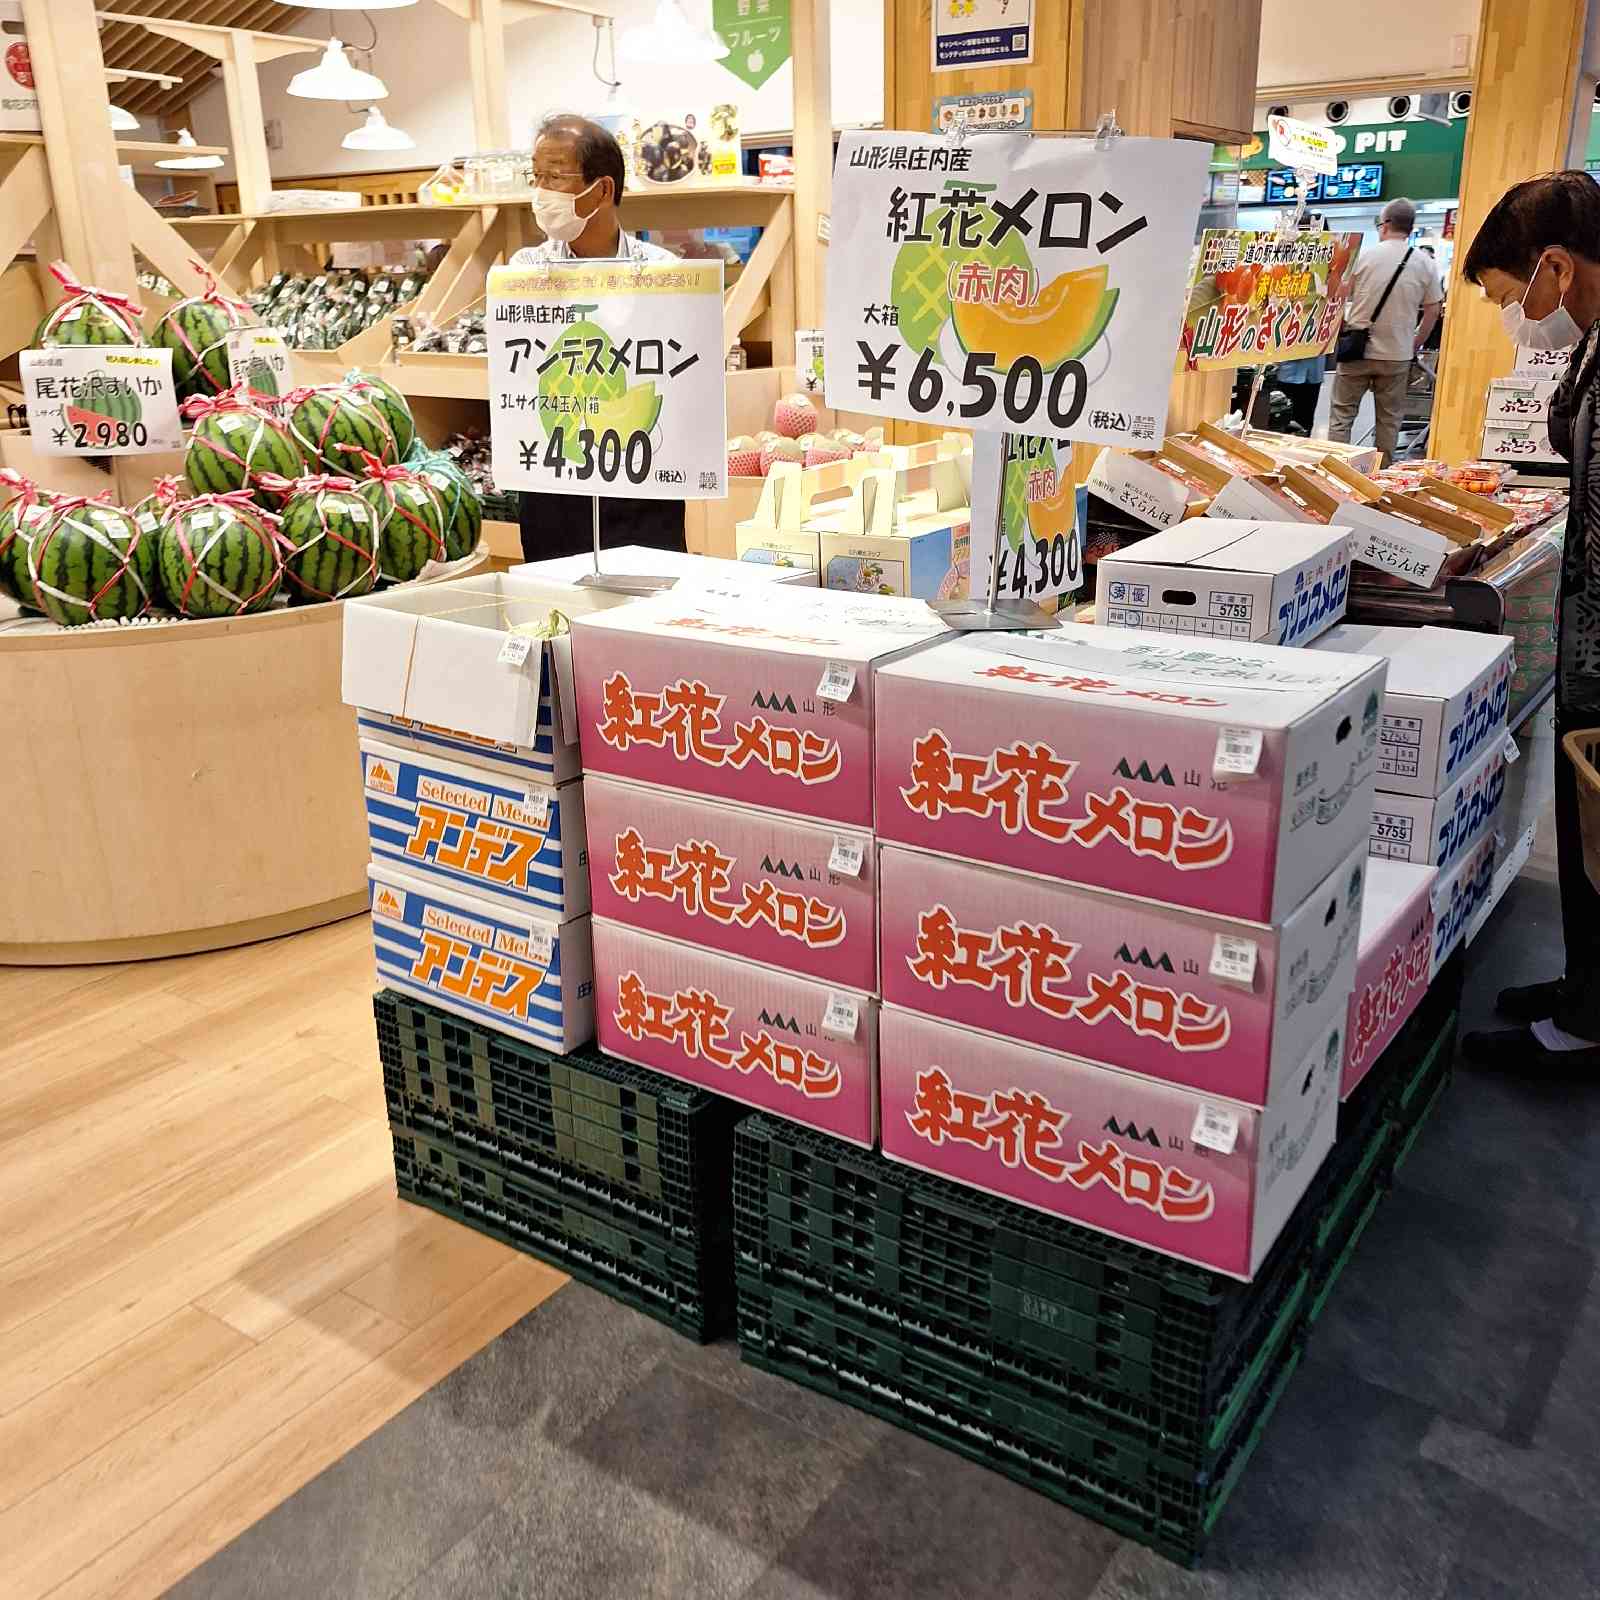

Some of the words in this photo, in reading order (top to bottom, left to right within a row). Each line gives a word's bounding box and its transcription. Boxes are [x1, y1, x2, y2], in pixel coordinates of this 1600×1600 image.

[727, 27, 782, 48] フルーツ
[849, 146, 973, 172] 山形県庄内産
[1354, 130, 1407, 154] PIT
[886, 186, 1149, 255] 紅花メロン
[947, 261, 1042, 307] (赤肉)
[495, 304, 577, 324] 山形県庄内産
[863, 303, 899, 327] 大箱
[1190, 298, 1342, 358] 山形のさくらんぼ
[504, 337, 700, 378] アンデスメロン
[1527, 350, 1570, 366] ぶどう
[35, 376, 163, 399] 尾花沢すいか
[856, 340, 1089, 429] ¥6,500
[1087, 410, 1132, 432] (税込)
[1499, 398, 1542, 414] ぶどう
[519, 426, 652, 485] ¥4,300
[1494, 438, 1537, 455] ぶどう
[654, 470, 687, 484] (税込)
[1119, 490, 1174, 526] さくらんぼ
[1364, 543, 1431, 577] さくらんぼ
[1219, 604, 1247, 618] 5759
[596, 671, 842, 785] 紅花メロン
[420, 779, 489, 814] Selected
[900, 729, 1234, 871] 紅花メロン
[405, 802, 547, 891] アンデス
[1376, 823, 1407, 840] 5759
[608, 826, 847, 949] 紅花メロン
[424, 907, 492, 945] Selected
[411, 930, 547, 1023] アンデス
[905, 904, 1231, 1052] 紅花メロン
[613, 970, 842, 1098] 紅花メロン
[905, 1066, 1215, 1221] 紅花メロン
